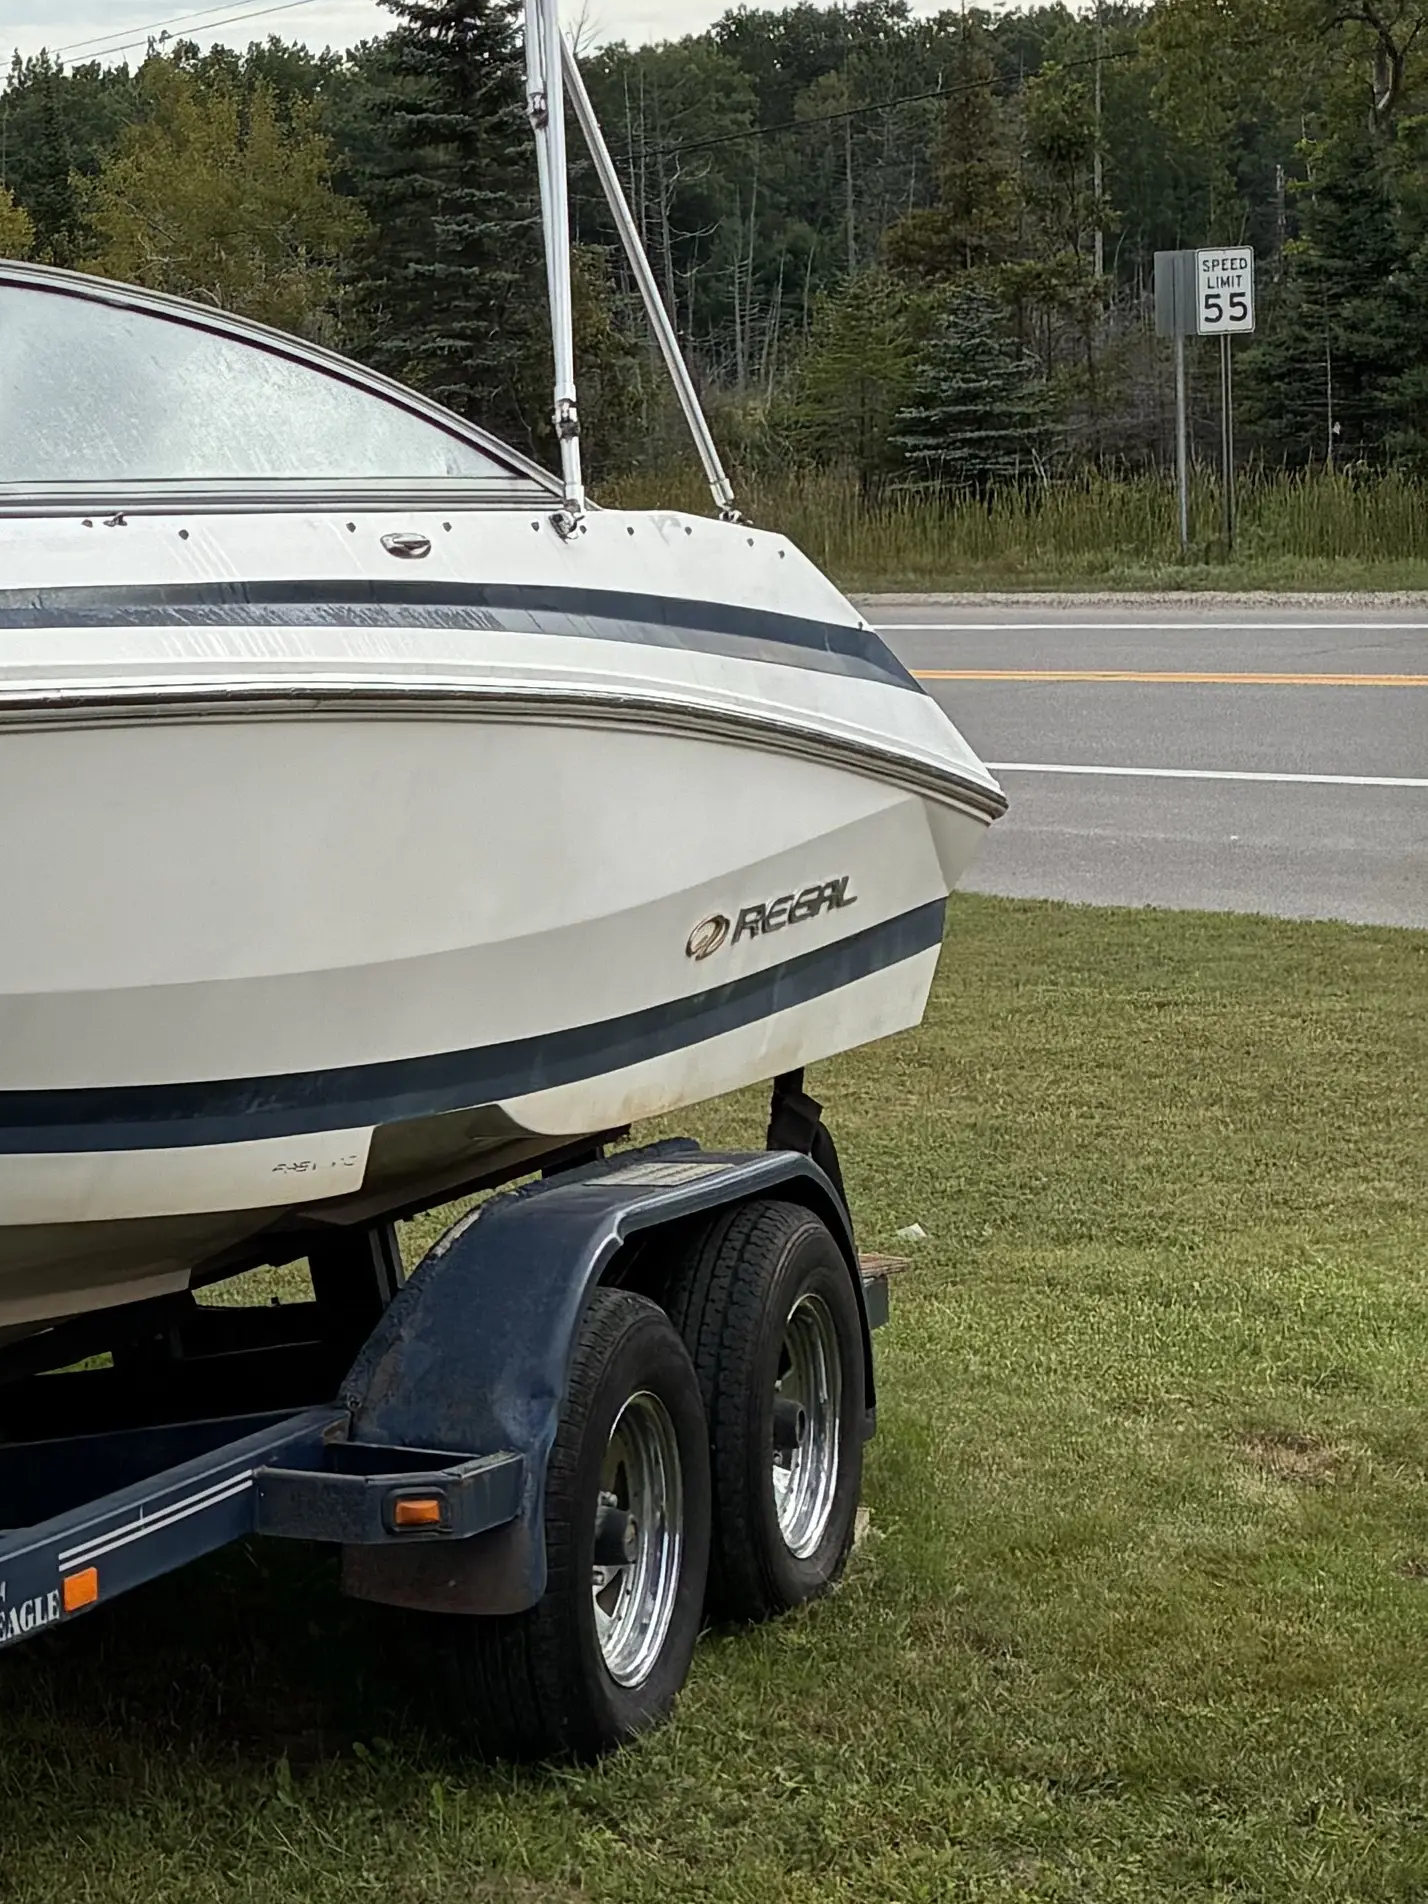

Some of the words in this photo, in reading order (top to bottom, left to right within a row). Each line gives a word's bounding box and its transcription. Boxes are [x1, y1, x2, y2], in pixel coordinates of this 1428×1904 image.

[1202, 257, 1248, 273] SPEED
[1207, 274, 1243, 290] LIMIT
[1203, 292, 1248, 324] 55
[730, 875, 858, 946] REGAL
